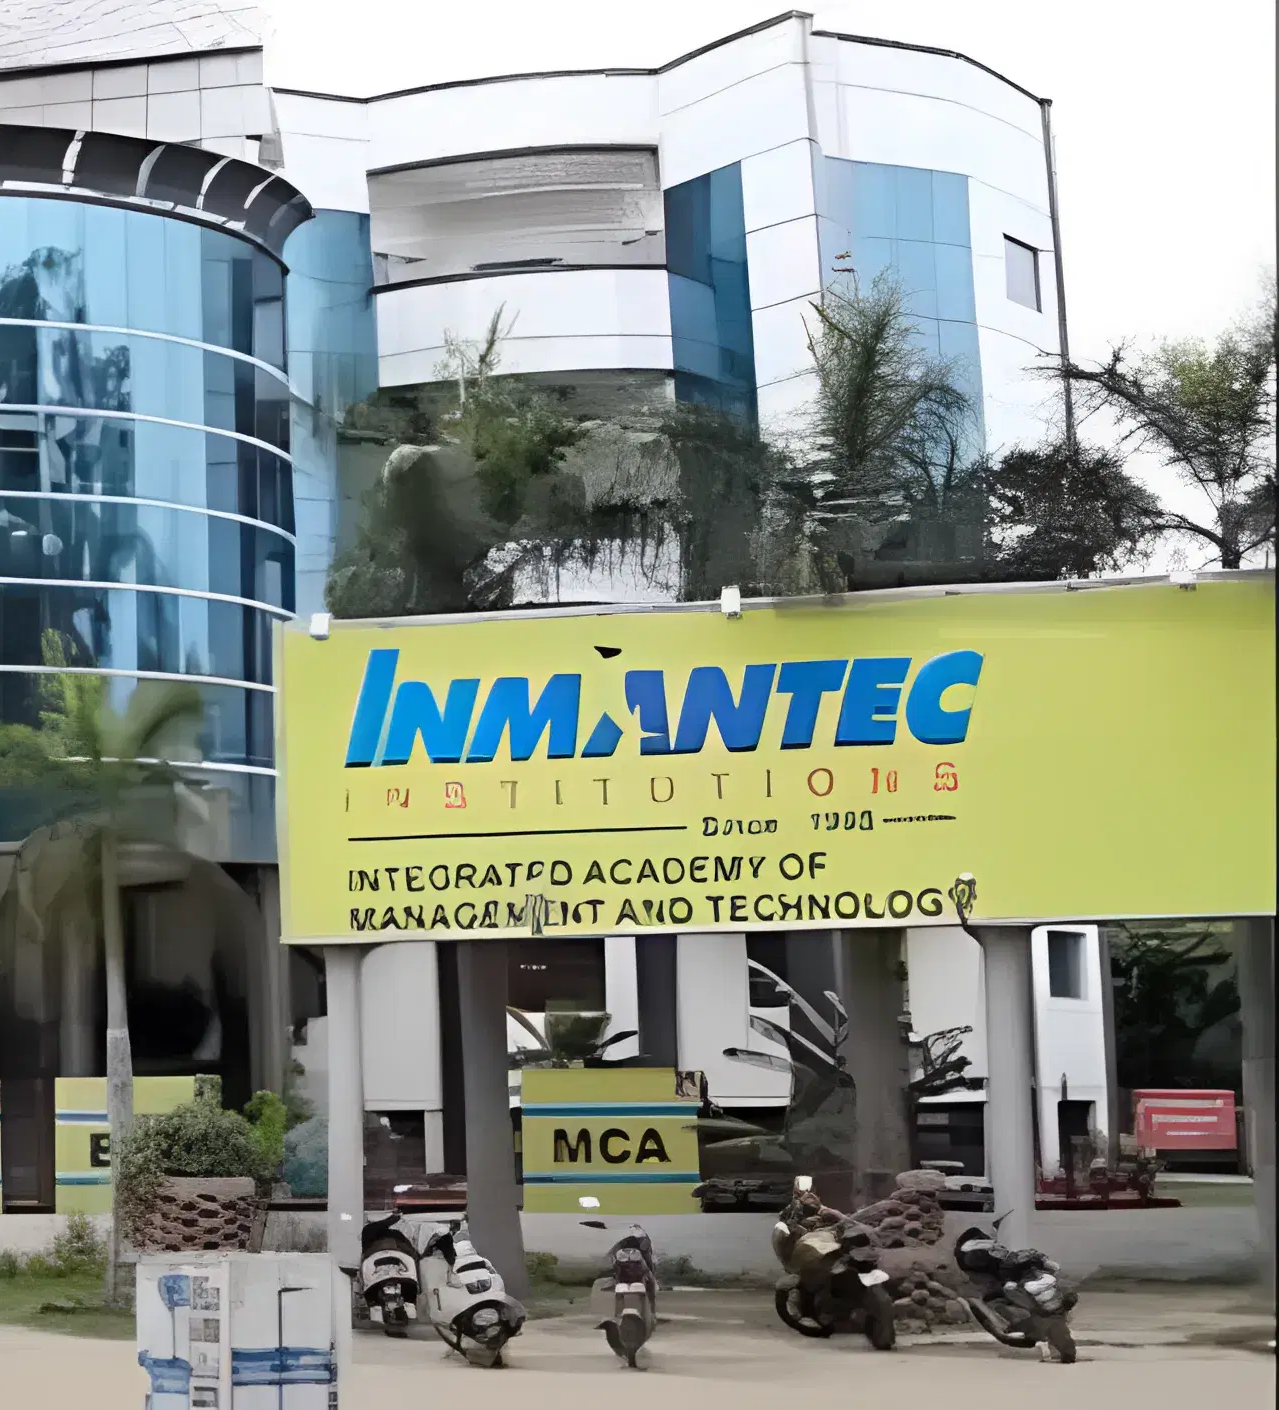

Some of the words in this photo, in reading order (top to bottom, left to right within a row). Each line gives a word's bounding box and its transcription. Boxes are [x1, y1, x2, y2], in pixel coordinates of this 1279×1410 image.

[344, 649, 985, 768] INMANTEC
[582, 857, 766, 886] ACADEMY
[779, 852, 827, 880] OF
[705, 884, 975, 923] TECHNOLOG
[554, 1127, 672, 1164] MCA
